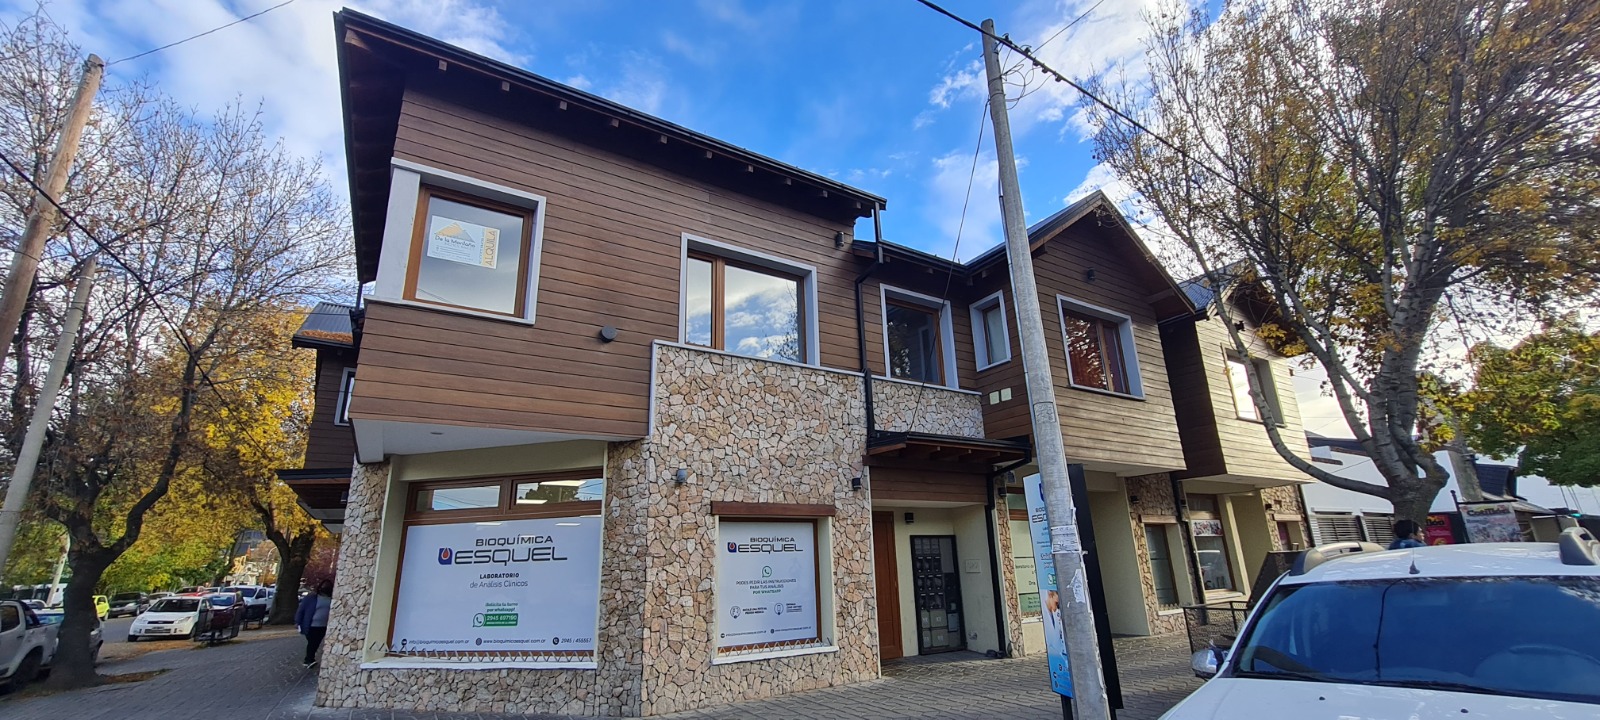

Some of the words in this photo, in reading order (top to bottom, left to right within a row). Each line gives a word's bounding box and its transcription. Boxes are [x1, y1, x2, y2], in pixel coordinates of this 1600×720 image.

[485, 231, 496, 266] ALQUILA
[476, 534, 553, 547] BIOQUÍMICA
[454, 546, 568, 566] ESQUEL
[738, 544, 804, 554] ESQUEL
